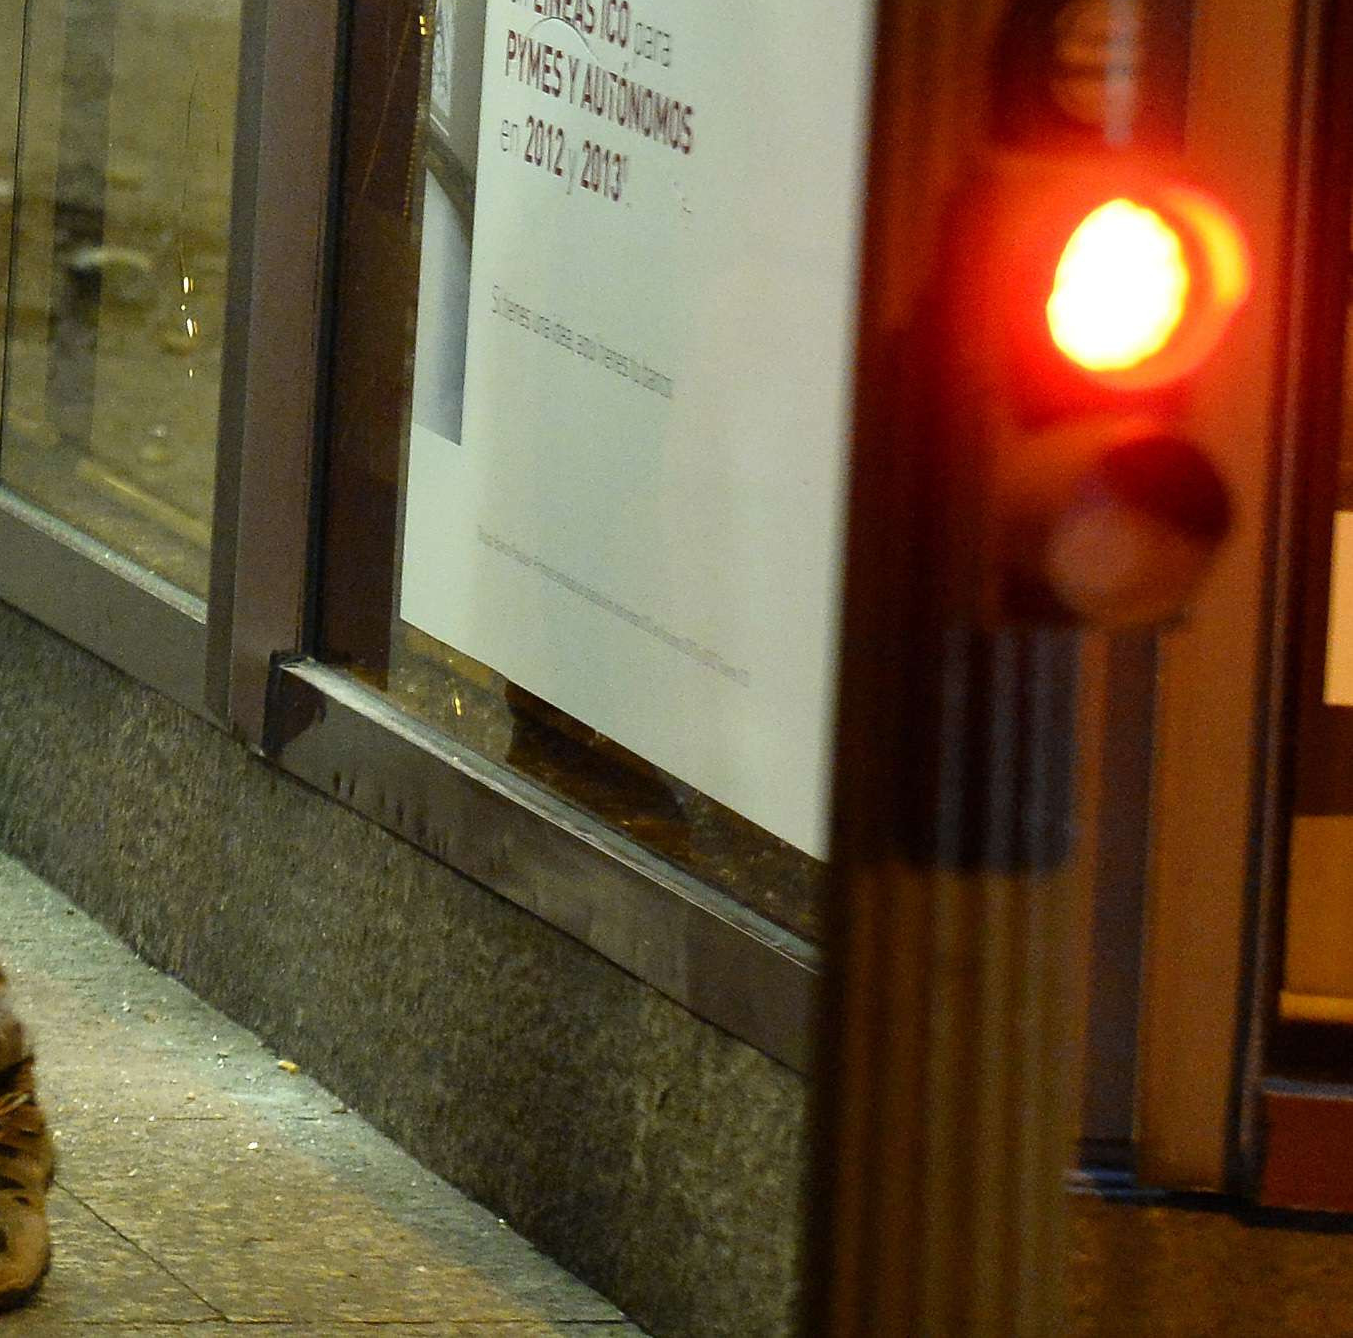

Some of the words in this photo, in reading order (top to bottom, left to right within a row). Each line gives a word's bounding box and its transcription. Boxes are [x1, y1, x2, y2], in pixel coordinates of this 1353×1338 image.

[505, 29, 563, 98] PYMES
[568, 55, 581, 105] Y
[580, 61, 694, 156] AUTÓNOMOS
[501, 119, 519, 158] en
[524, 115, 566, 178] 2012
